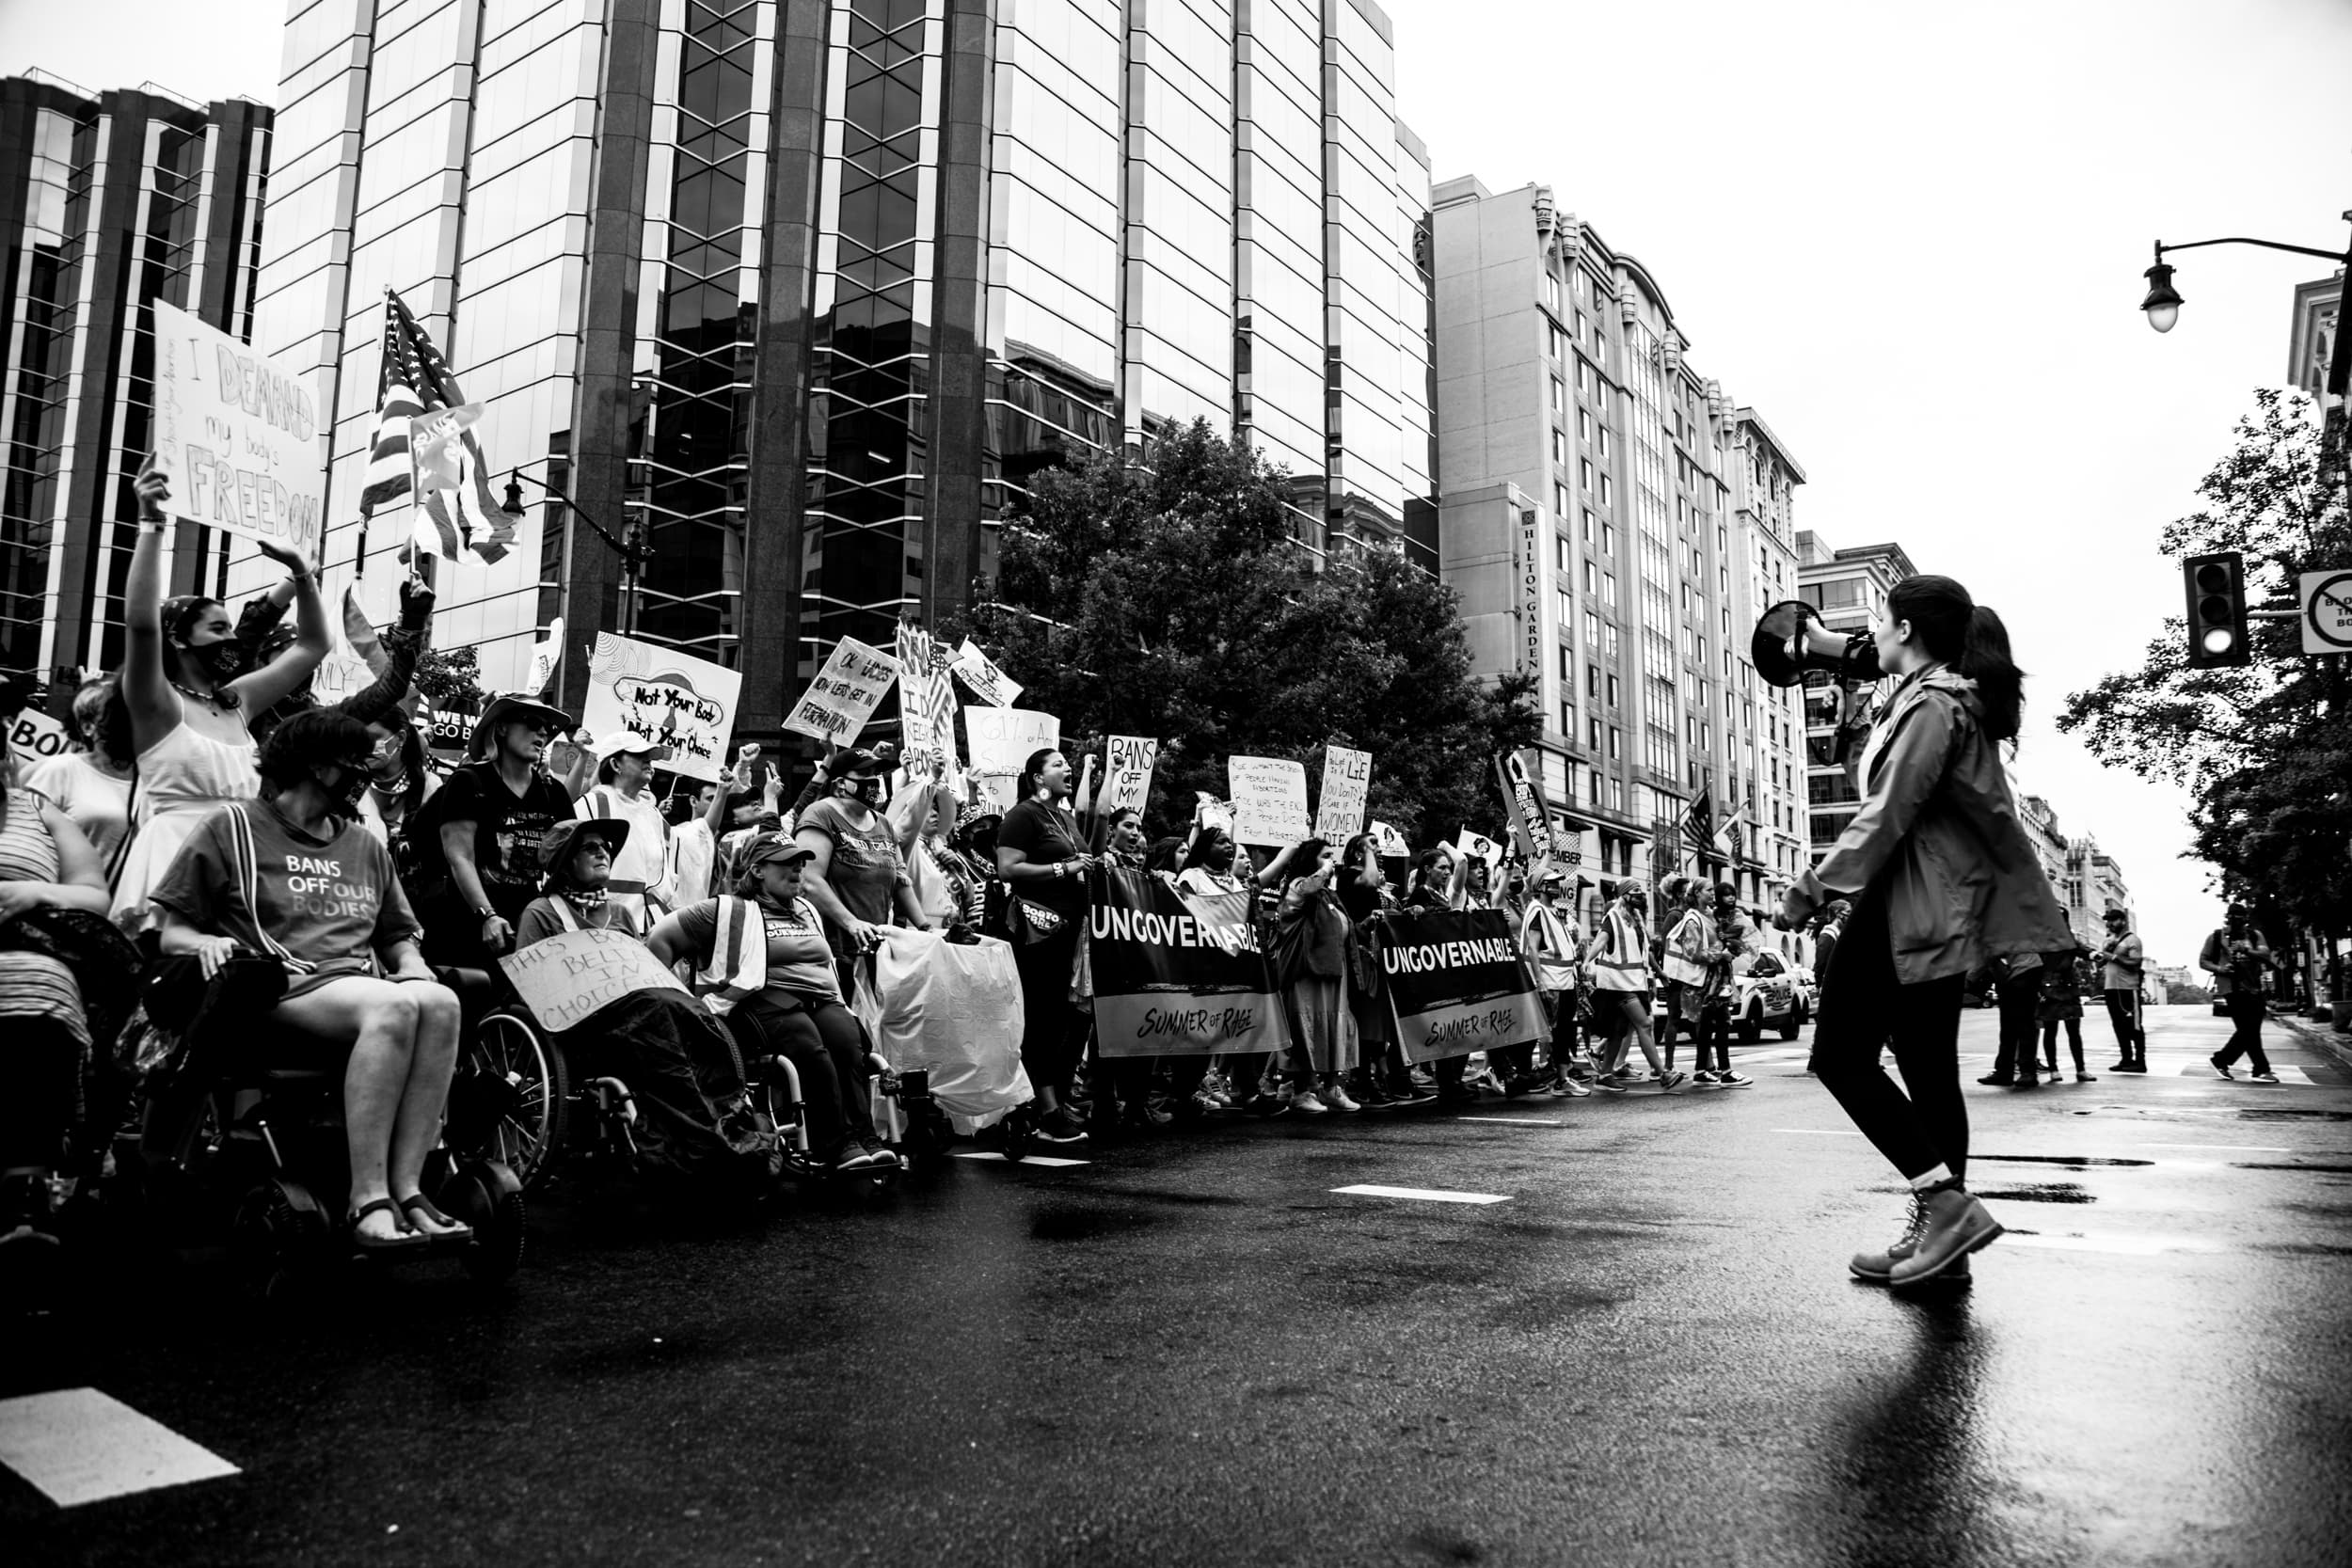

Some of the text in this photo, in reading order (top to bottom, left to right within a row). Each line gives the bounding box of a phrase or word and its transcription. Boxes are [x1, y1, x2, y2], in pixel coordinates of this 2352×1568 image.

[188, 339, 313, 442] I DEMAND
[185, 443, 318, 555] FREEDOM
[1524, 529, 1536, 596] HILTON
[1526, 600, 1538, 670] GARDEN
[634, 687, 660, 706] Not
[664, 688, 694, 713] Your
[864, 693, 878, 707] IN
[904, 689, 918, 716] I
[433, 710, 461, 726] WE
[433, 722, 459, 738] GO
[798, 702, 852, 735] FORMATION
[627, 721, 712, 760] Not Your Choice
[987, 781, 999, 796] to
[1120, 771, 1142, 784] OFF
[1118, 785, 1139, 804] MY
[1319, 810, 1362, 833] WOMEN
[1324, 832, 1345, 847] DIE
[285, 854, 342, 879] BANS
[1527, 849, 1581, 865] NOEMBER
[288, 876, 376, 903] OFF OUR
[293, 895, 376, 921] BODIES
[1020, 902, 1060, 923] BORTO
[1091, 904, 1262, 955] UNGOVERNABLE
[509, 937, 566, 973] THIS
[1383, 937, 1517, 974] UNGOVERNABLE
[598, 962, 641, 982] IN
[1772, 984, 1792, 1001] POLICE
[1137, 1007, 1256, 1039] SUMMER OF RAGE
[1424, 1015, 1480, 1047] SUMMER
[1489, 1008, 1517, 1035] RAGE
